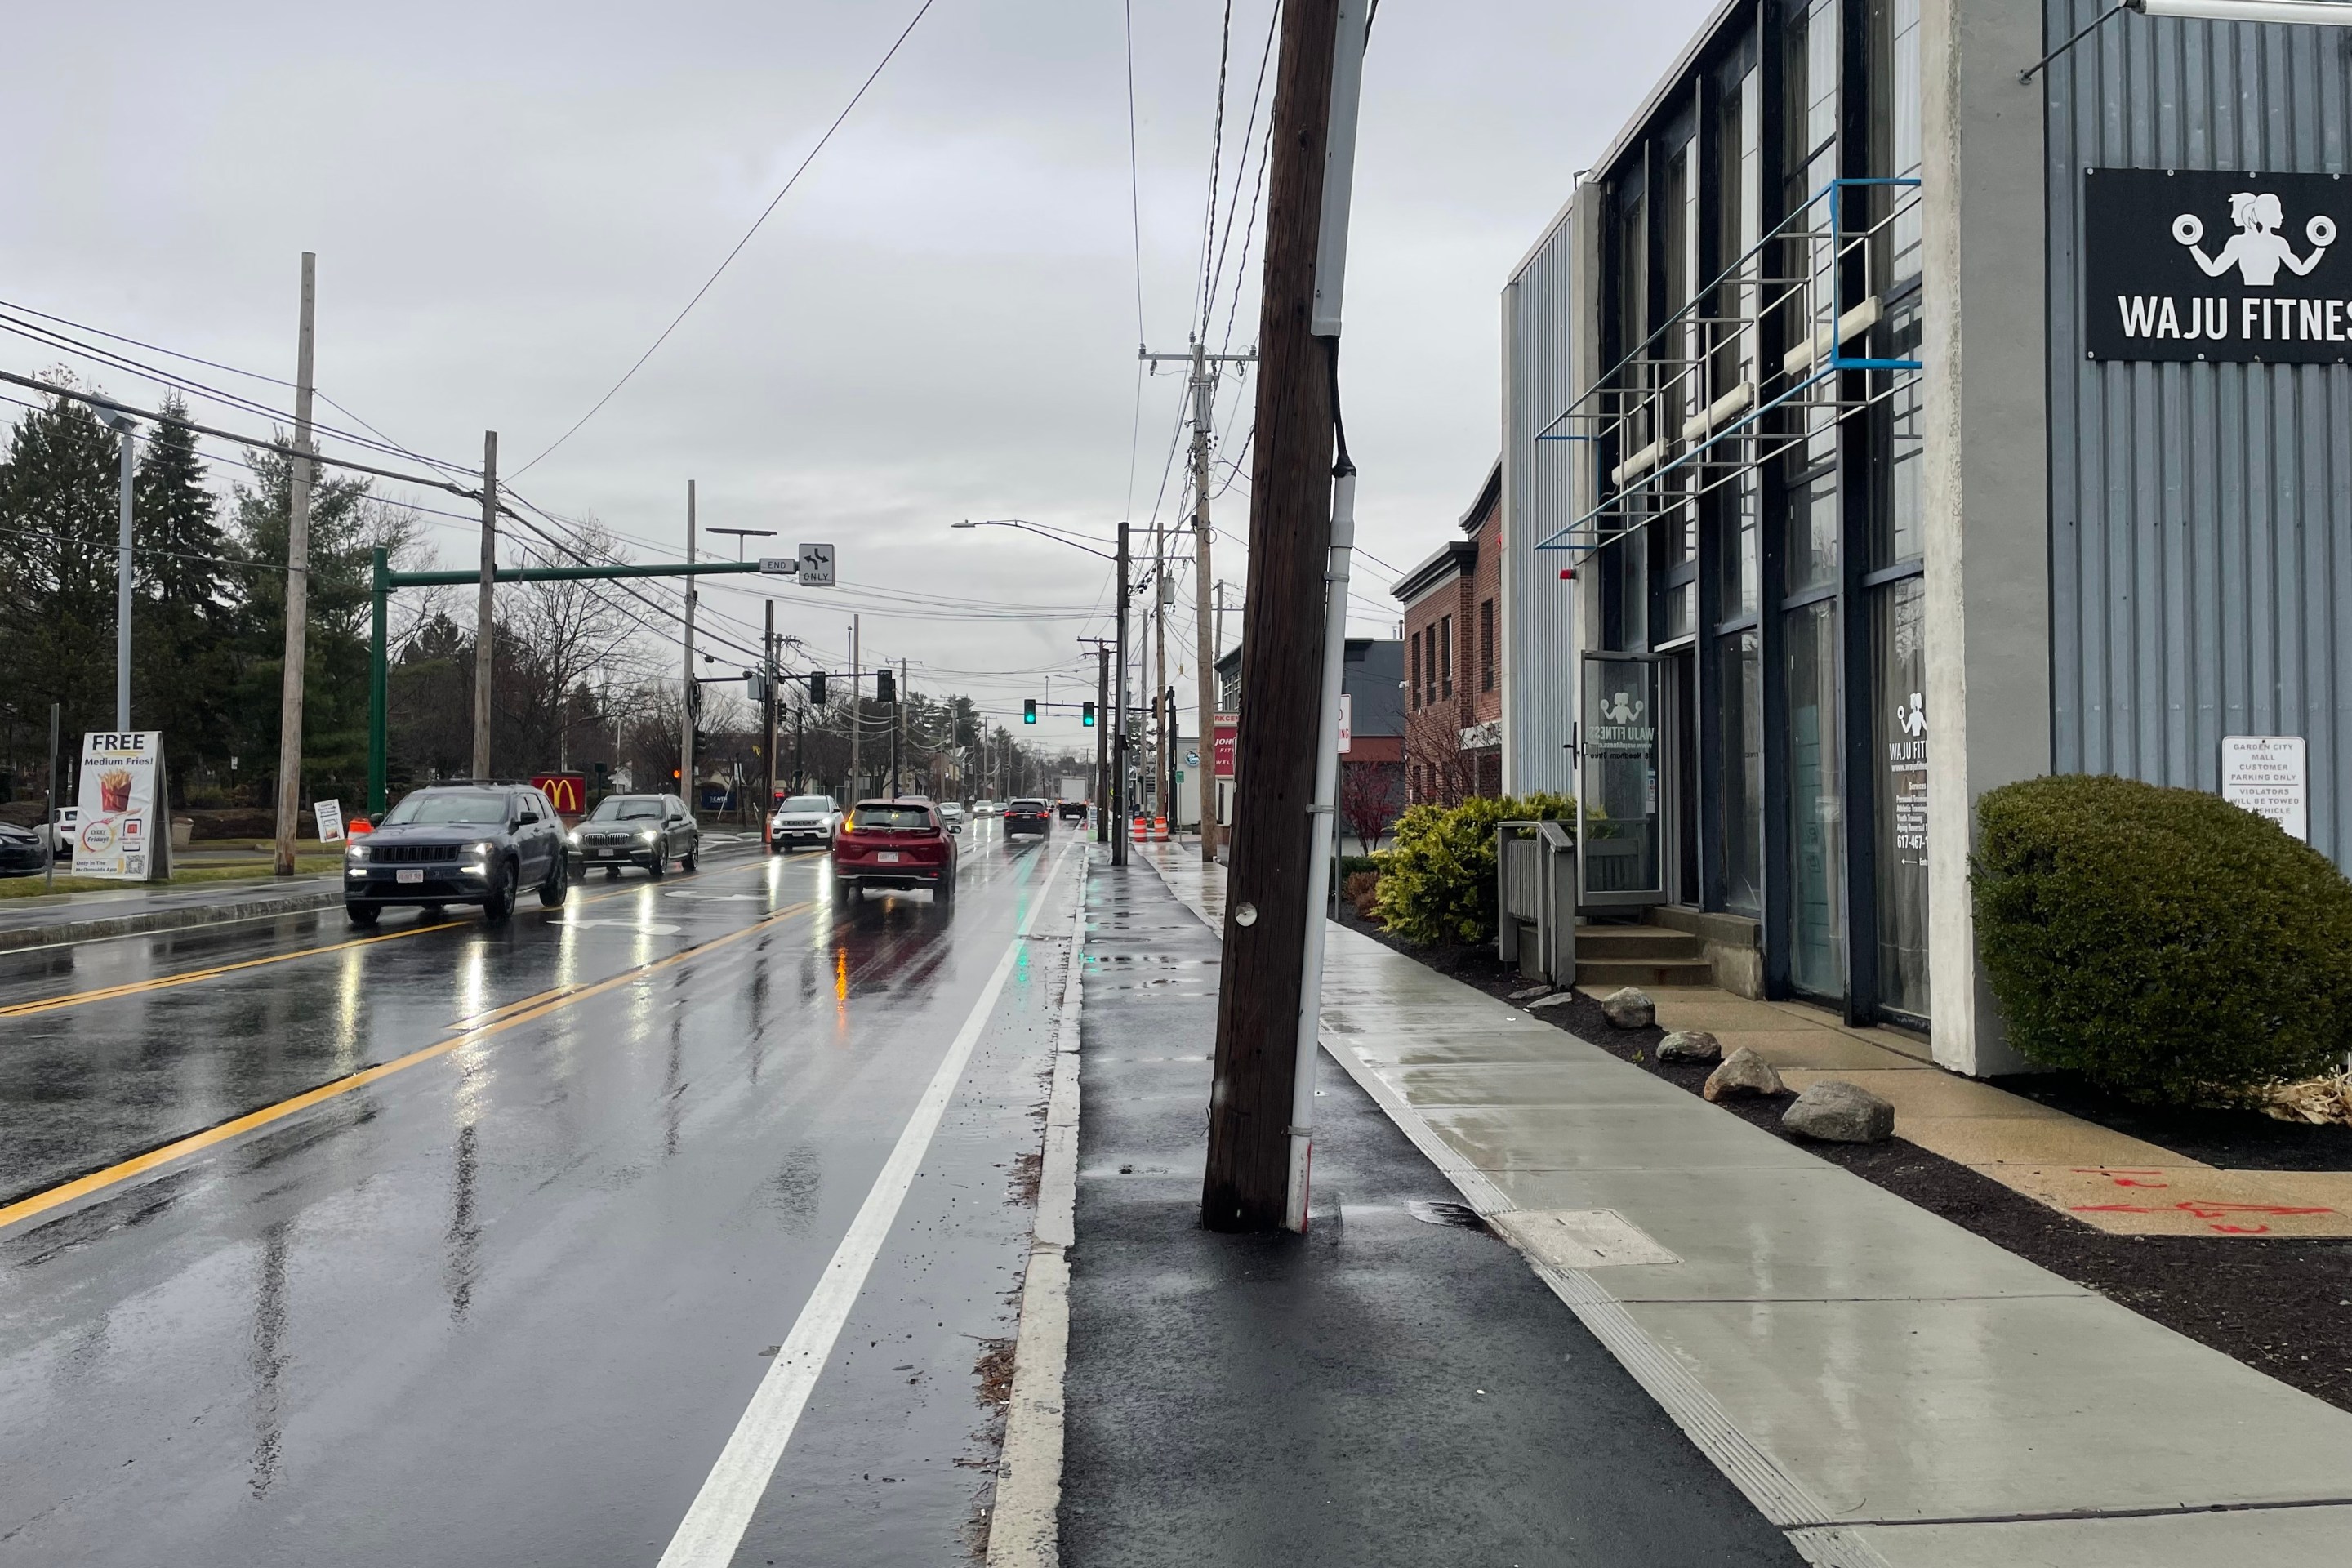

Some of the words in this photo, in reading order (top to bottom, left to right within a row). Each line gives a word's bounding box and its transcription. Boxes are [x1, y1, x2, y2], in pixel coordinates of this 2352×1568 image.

[2118, 295, 2228, 341] WAJU
[2241, 297, 2352, 341] FITNE
[768, 561, 786, 569] END
[804, 572, 828, 581] ONLY
[92, 733, 145, 751] FREE
[1889, 741, 1911, 760] WAJU
[84, 757, 123, 766] Medium
[126, 756, 154, 766] Fries!
